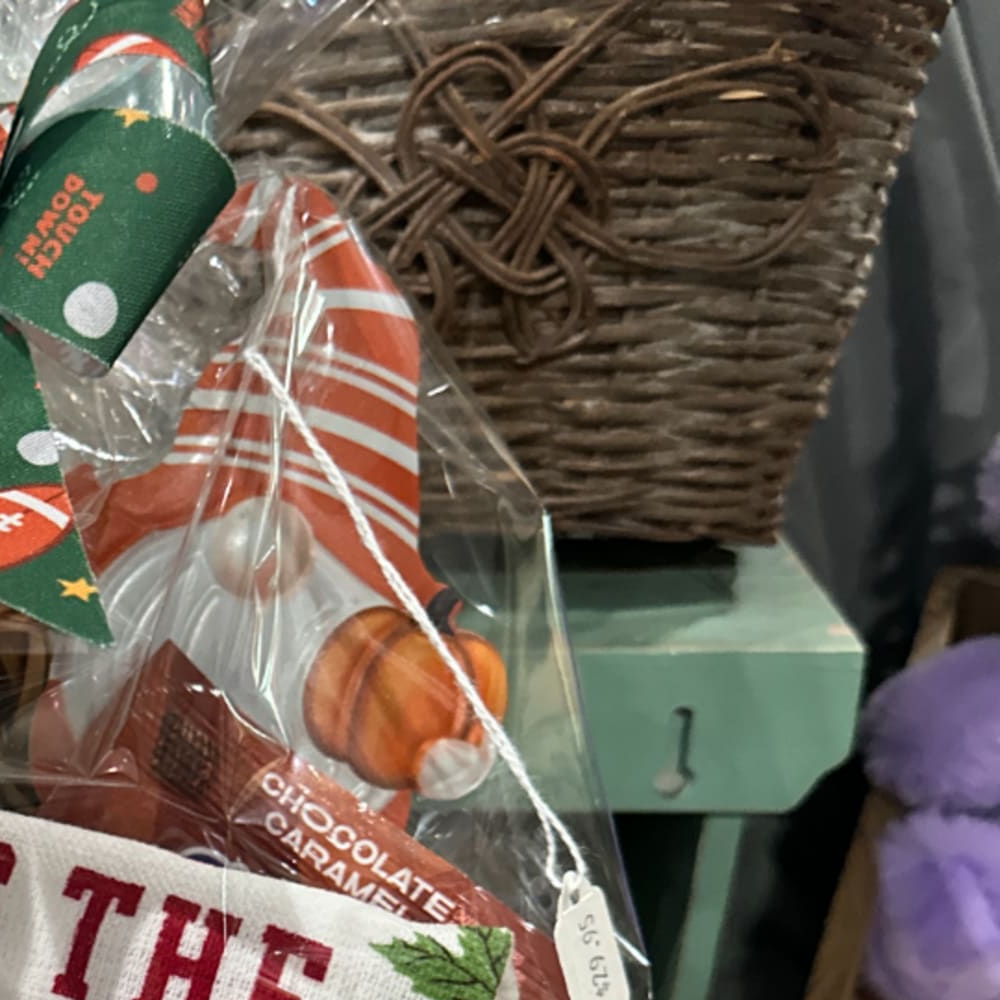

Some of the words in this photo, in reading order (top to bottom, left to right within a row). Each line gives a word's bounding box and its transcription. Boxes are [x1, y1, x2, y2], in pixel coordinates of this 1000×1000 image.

[14, 172, 86, 266] DOWN!
[27, 189, 105, 280] TOUCH
[261, 771, 457, 923] CHOCOLATE
